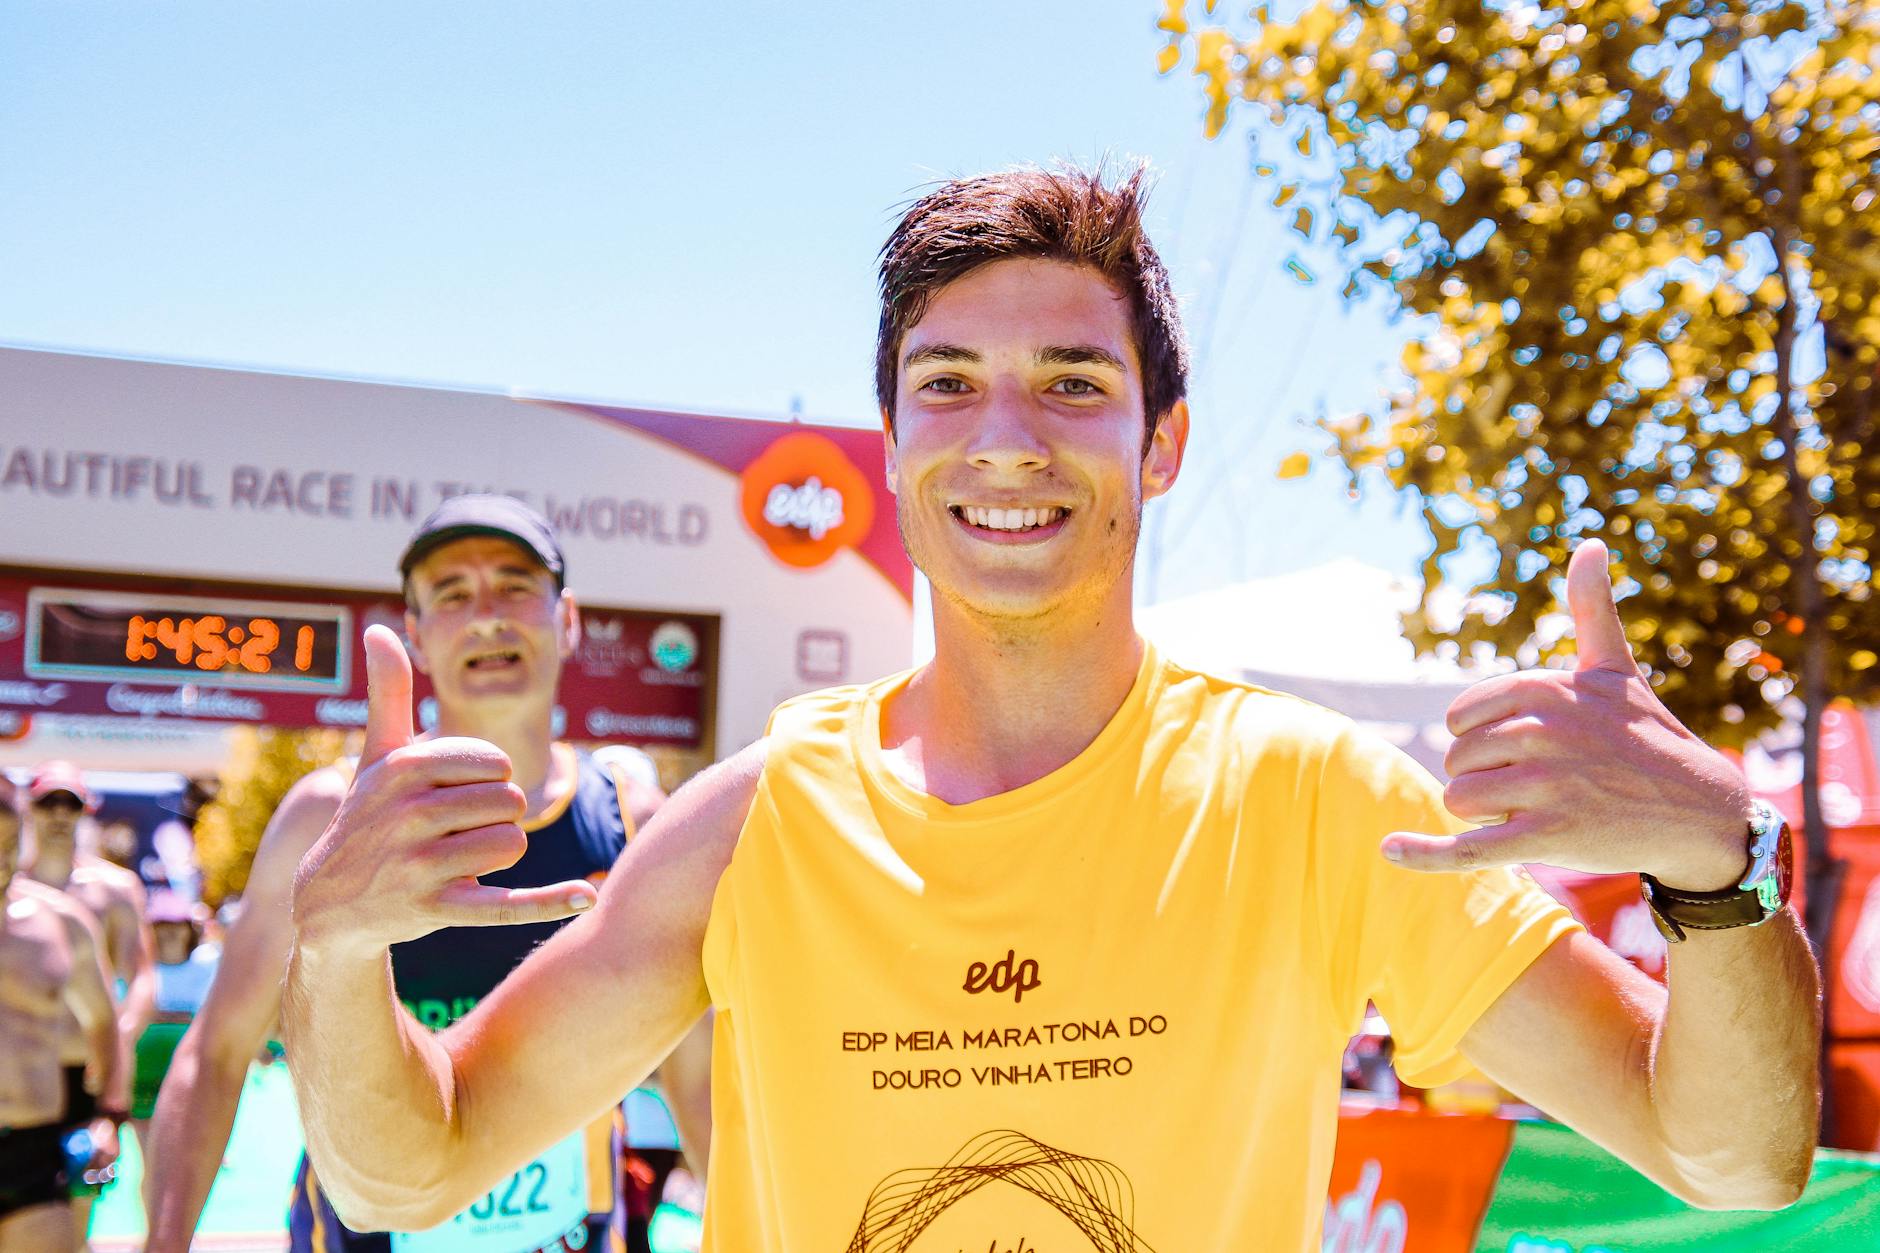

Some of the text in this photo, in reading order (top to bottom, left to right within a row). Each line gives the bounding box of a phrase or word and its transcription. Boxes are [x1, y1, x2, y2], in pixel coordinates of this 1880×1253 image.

[229, 464, 354, 520] RACE
[369, 475, 416, 521] IN
[544, 493, 709, 546] WORLD
[764, 476, 844, 540] edp
[126, 615, 314, 673] 1:45:21
[962, 949, 1042, 1003] edp
[842, 1014, 1168, 1052] EDP MEIA MARATONA DO
[872, 1056, 1133, 1090] DOURO VINHATEIRO
[1322, 1158, 1407, 1253] dp
